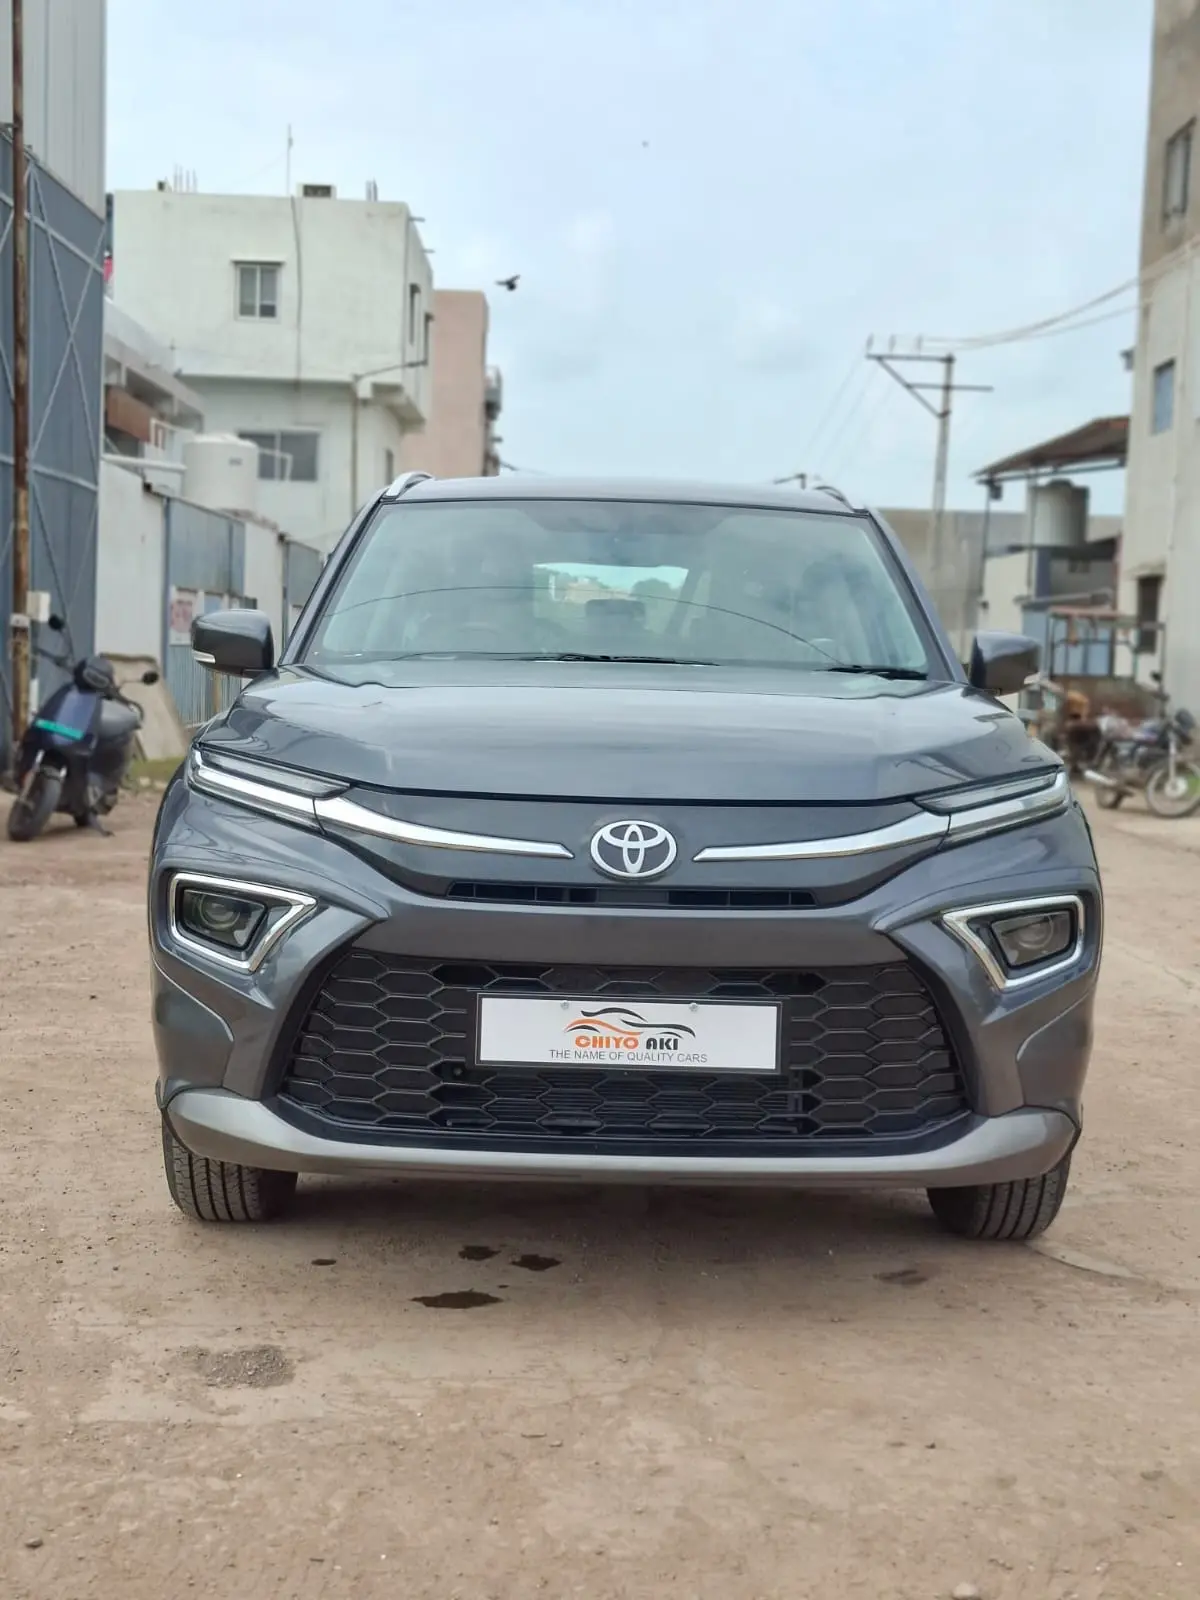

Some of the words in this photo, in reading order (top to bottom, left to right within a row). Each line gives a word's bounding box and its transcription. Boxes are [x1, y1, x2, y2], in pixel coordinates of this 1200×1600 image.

[575, 1035, 639, 1049] CHIYO
[645, 1037, 679, 1050] AKI
[549, 1049, 571, 1059] THE
[574, 1050, 606, 1060] NAME
[609, 1051, 625, 1061] OF
[627, 1051, 674, 1063] QUALITY
[677, 1053, 708, 1063] CARS
